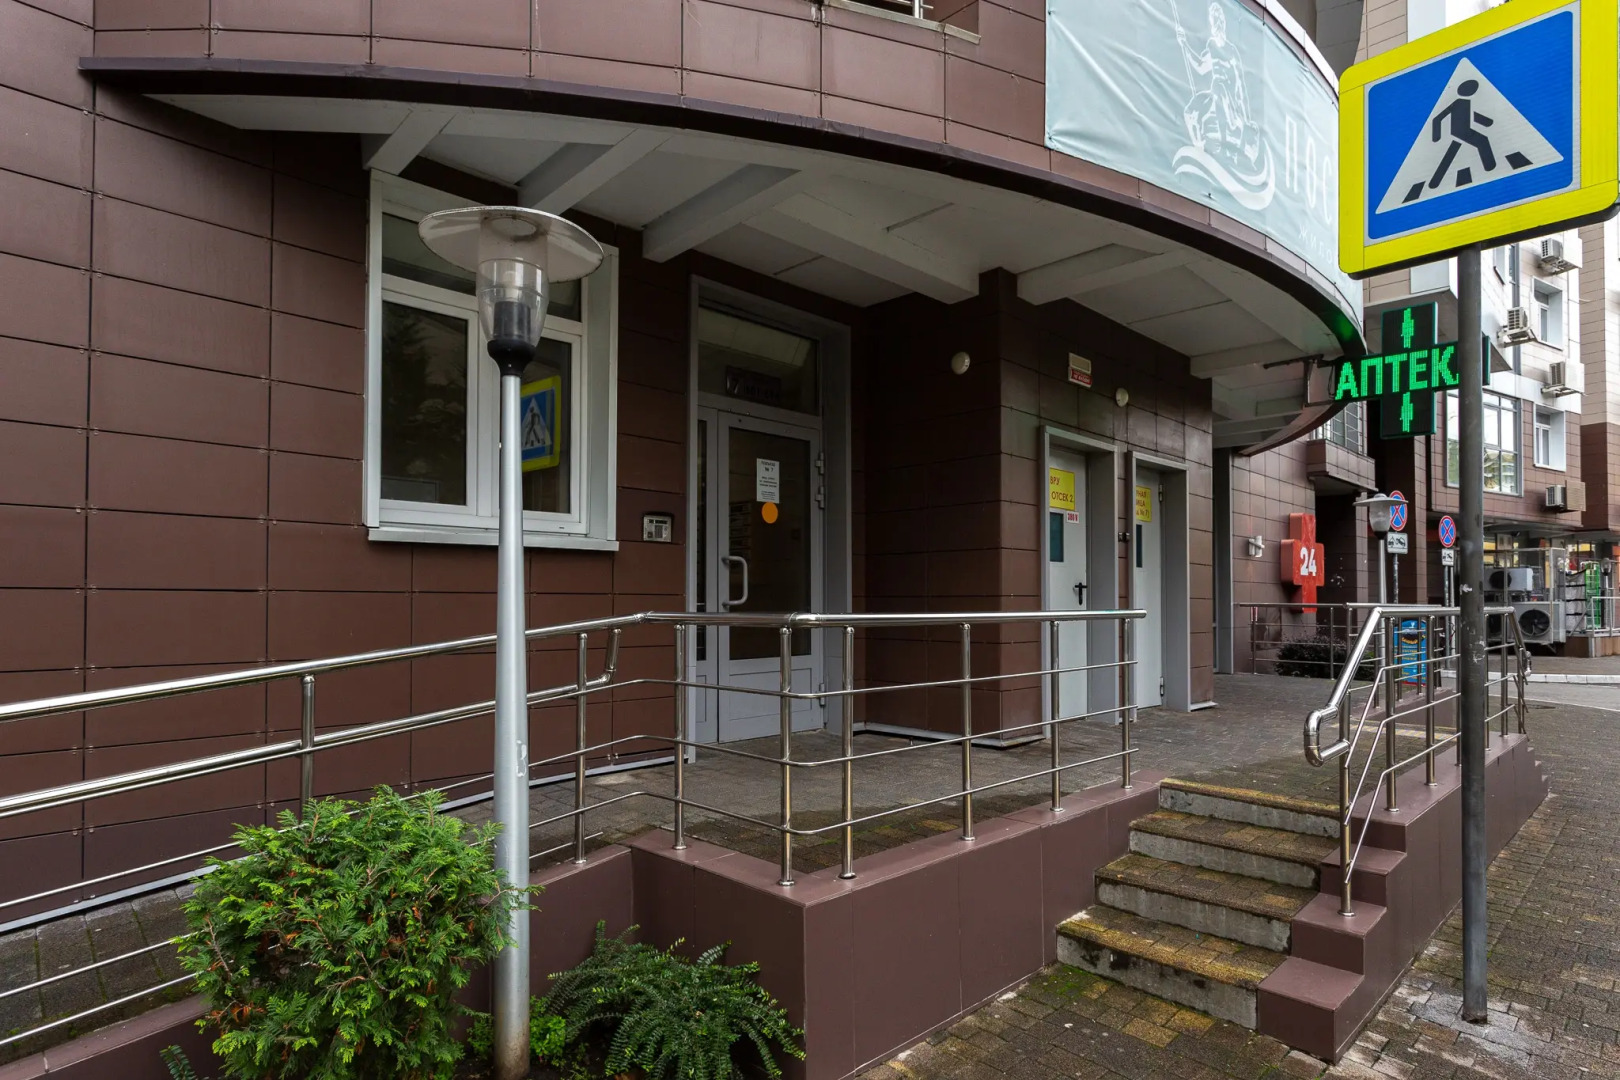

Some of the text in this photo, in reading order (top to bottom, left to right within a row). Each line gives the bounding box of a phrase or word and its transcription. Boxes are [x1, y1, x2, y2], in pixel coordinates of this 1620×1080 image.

[1285, 112, 1333, 226] ПОС
[1298, 224, 1334, 265] ЖИЛО
[1335, 345, 1459, 400] АПТЕК
[1051, 491, 1074, 503] ОТСЕК 2
[1300, 546, 1317, 577] 24
